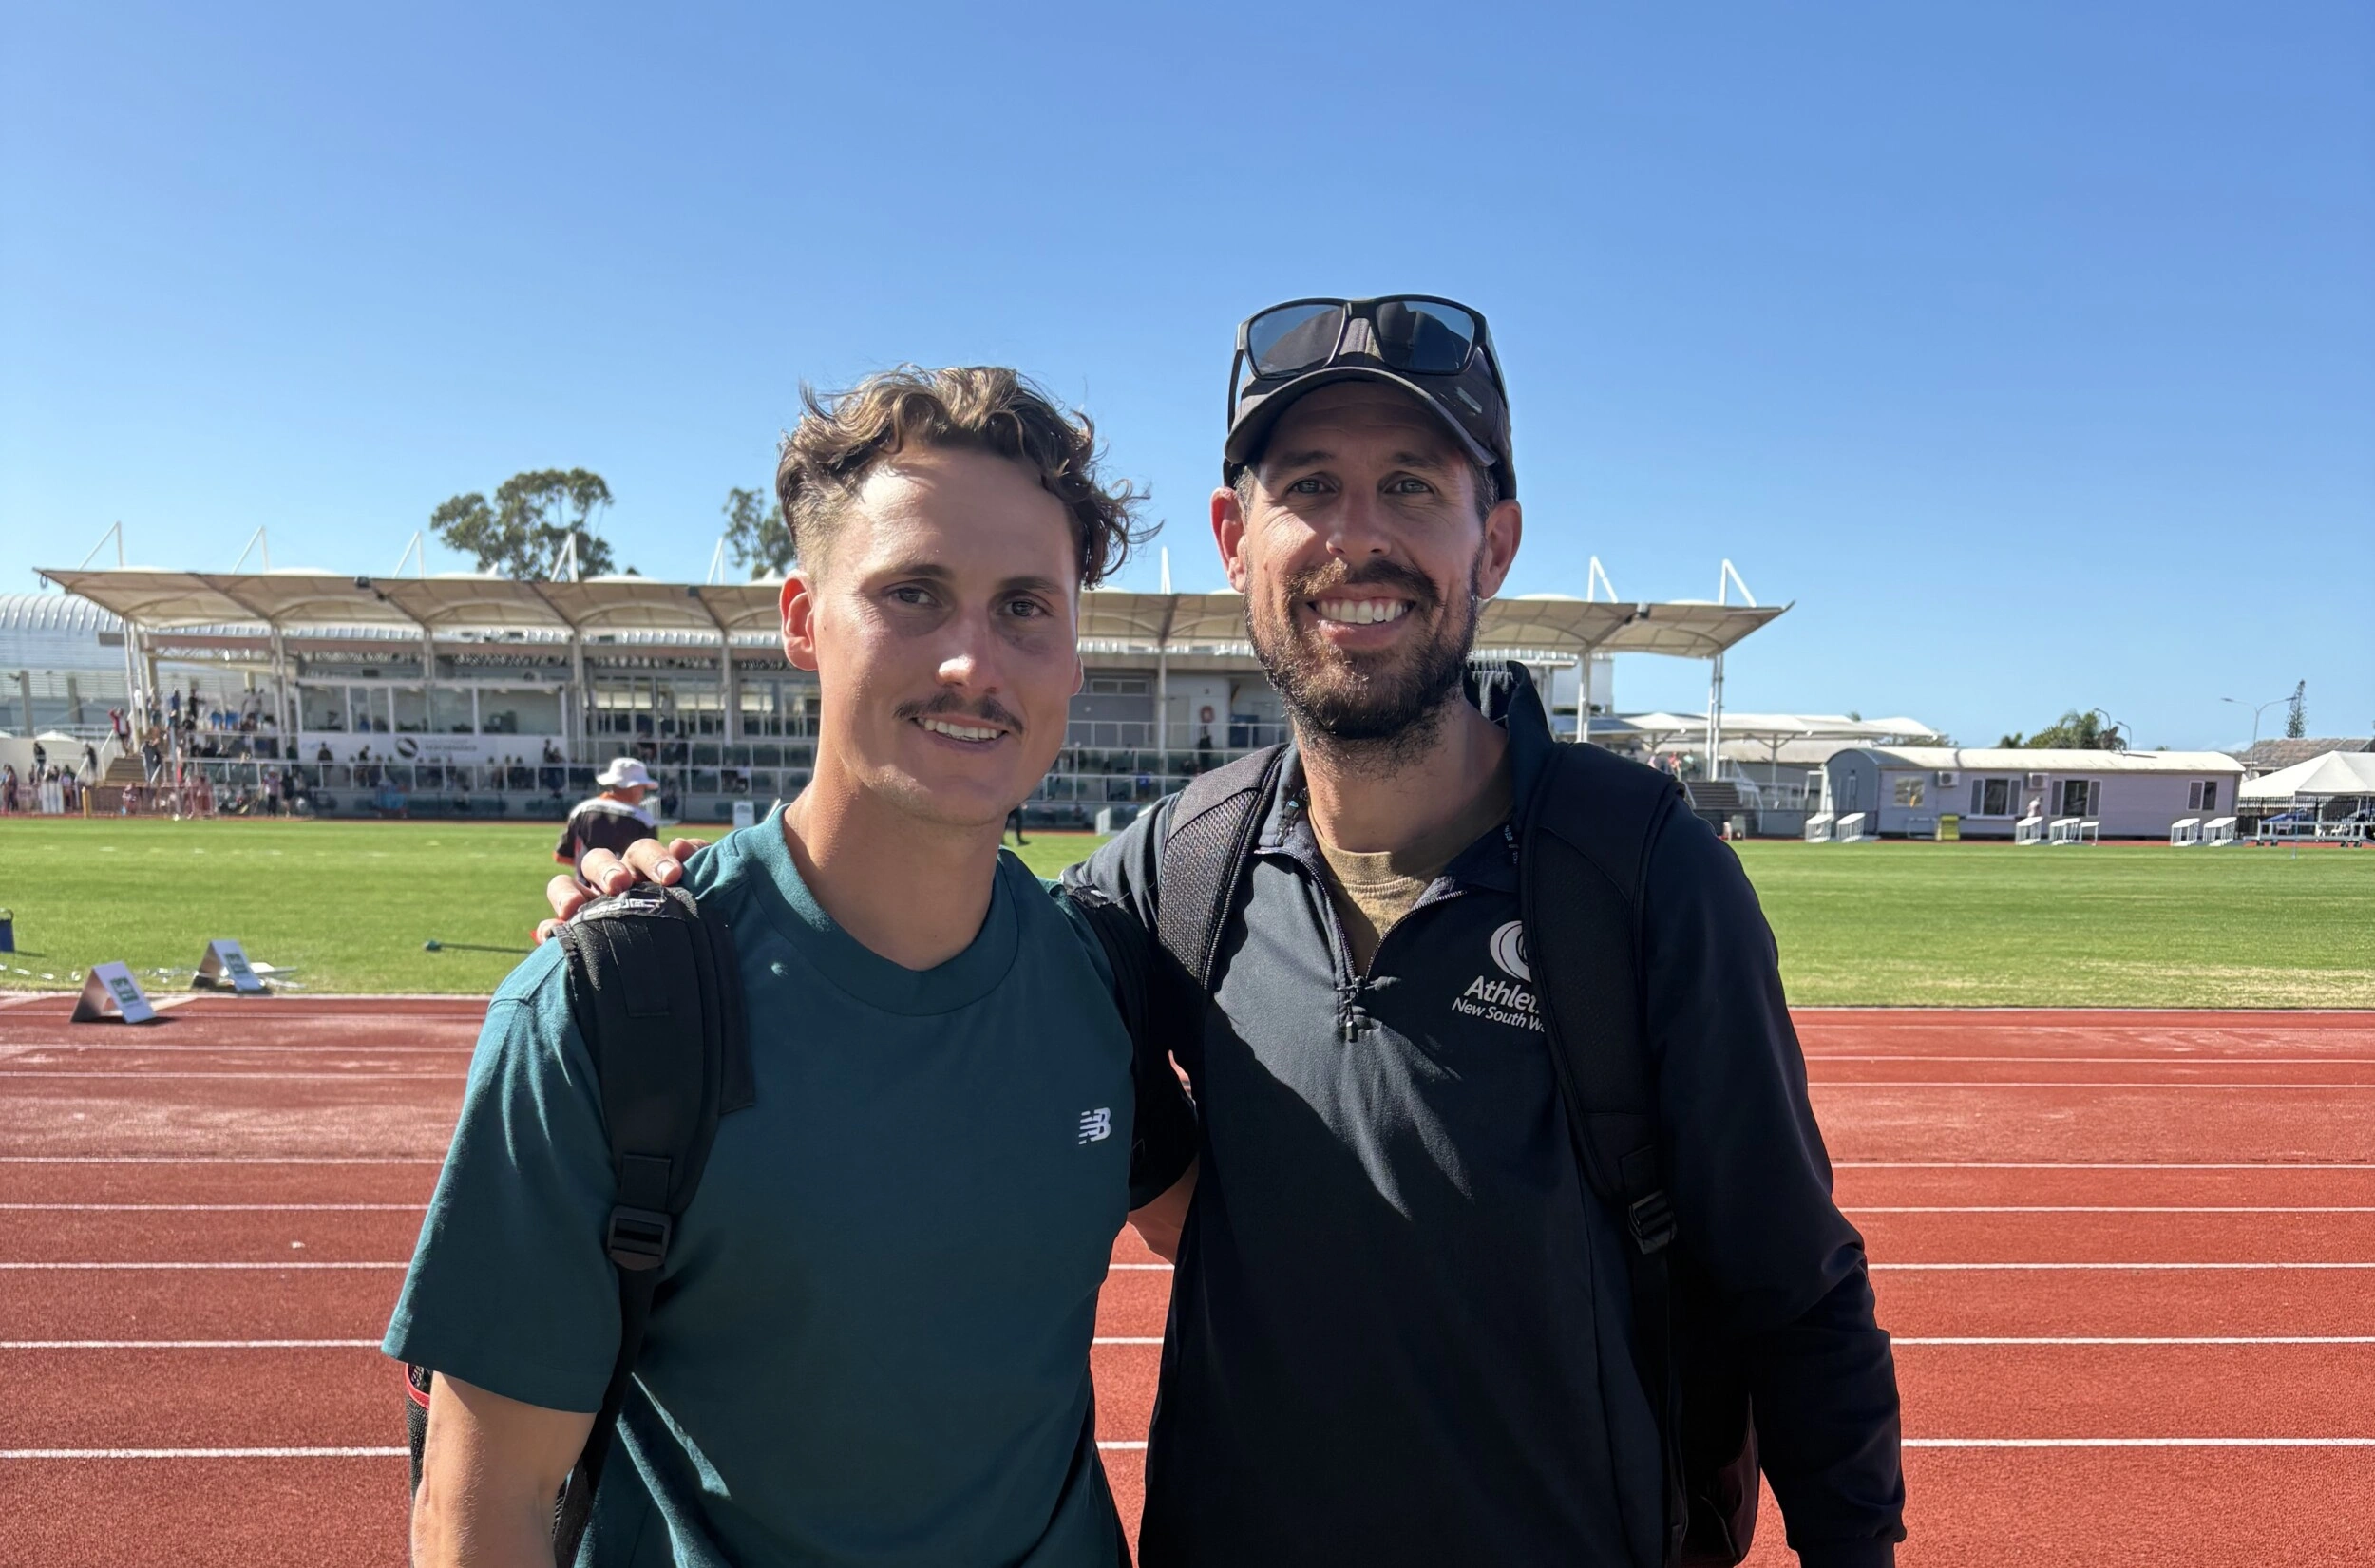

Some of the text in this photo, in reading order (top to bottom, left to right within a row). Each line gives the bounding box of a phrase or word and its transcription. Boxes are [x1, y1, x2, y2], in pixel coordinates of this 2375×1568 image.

[1463, 975, 1539, 1013] Athlet
[1452, 996, 1485, 1017] New
[1485, 1006, 1527, 1028] South
